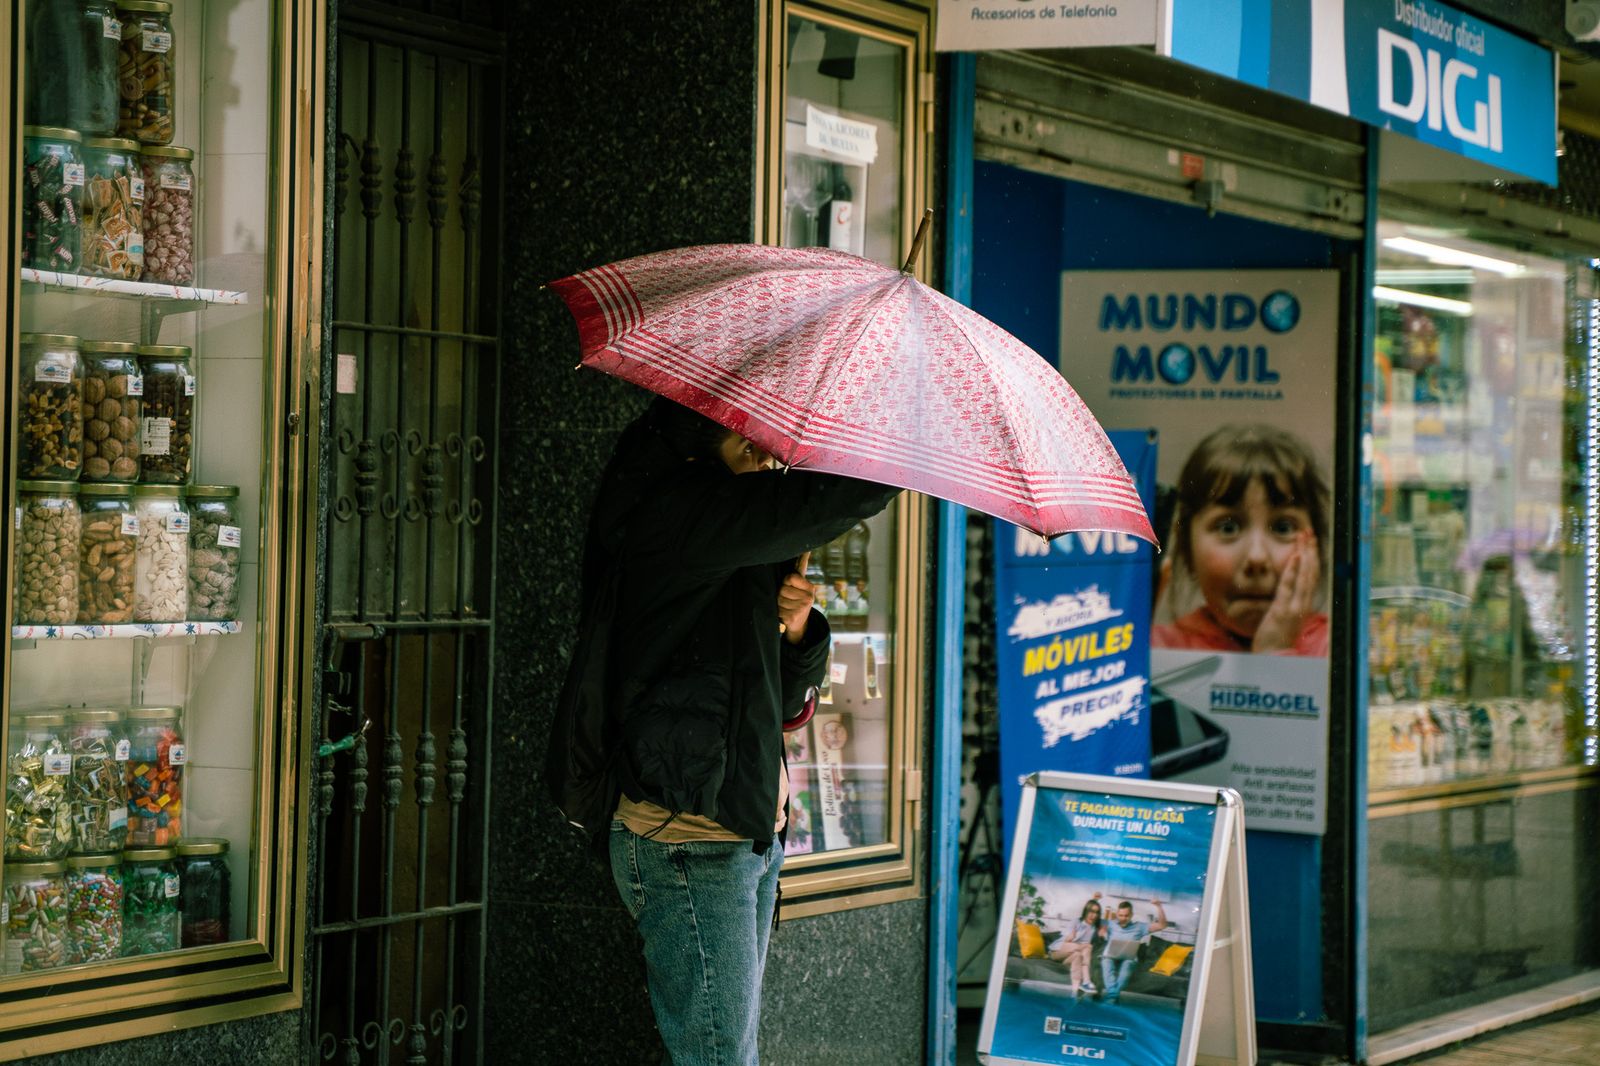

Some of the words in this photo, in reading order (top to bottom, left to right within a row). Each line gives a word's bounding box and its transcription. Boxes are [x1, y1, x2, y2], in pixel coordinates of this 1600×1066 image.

[971, 7, 1036, 20] Accesorios
[1039, 7, 1055, 18] de
[1060, 5, 1118, 18] Telefonía
[1396, 0, 1454, 42] Distribuidor
[1456, 21, 1485, 56] oficial
[1378, 27, 1503, 153] DIGI
[1099, 289, 1301, 334] MUNDO
[1111, 342, 1280, 385] MOVIL
[1110, 388, 1196, 399] PROTECTORES
[1200, 389, 1216, 399] DE
[1220, 389, 1284, 400] PANTALLA
[1023, 622, 1135, 677] MÓVILES
[1035, 679, 1060, 699] AL
[1062, 660, 1126, 692] MEJOR
[1060, 690, 1124, 719] PRECIO
[1210, 691, 1320, 712] HIDROGEL
[1065, 801, 1077, 812] TE
[1079, 802, 1135, 818] PAGAMOS
[1137, 808, 1151, 819] TU
[1154, 810, 1185, 823] CASA
[1073, 816, 1125, 832] DURANTE
[1127, 821, 1143, 833] UN
[1145, 822, 1170, 836] AÑO
[1061, 1044, 1106, 1059] DIGI
